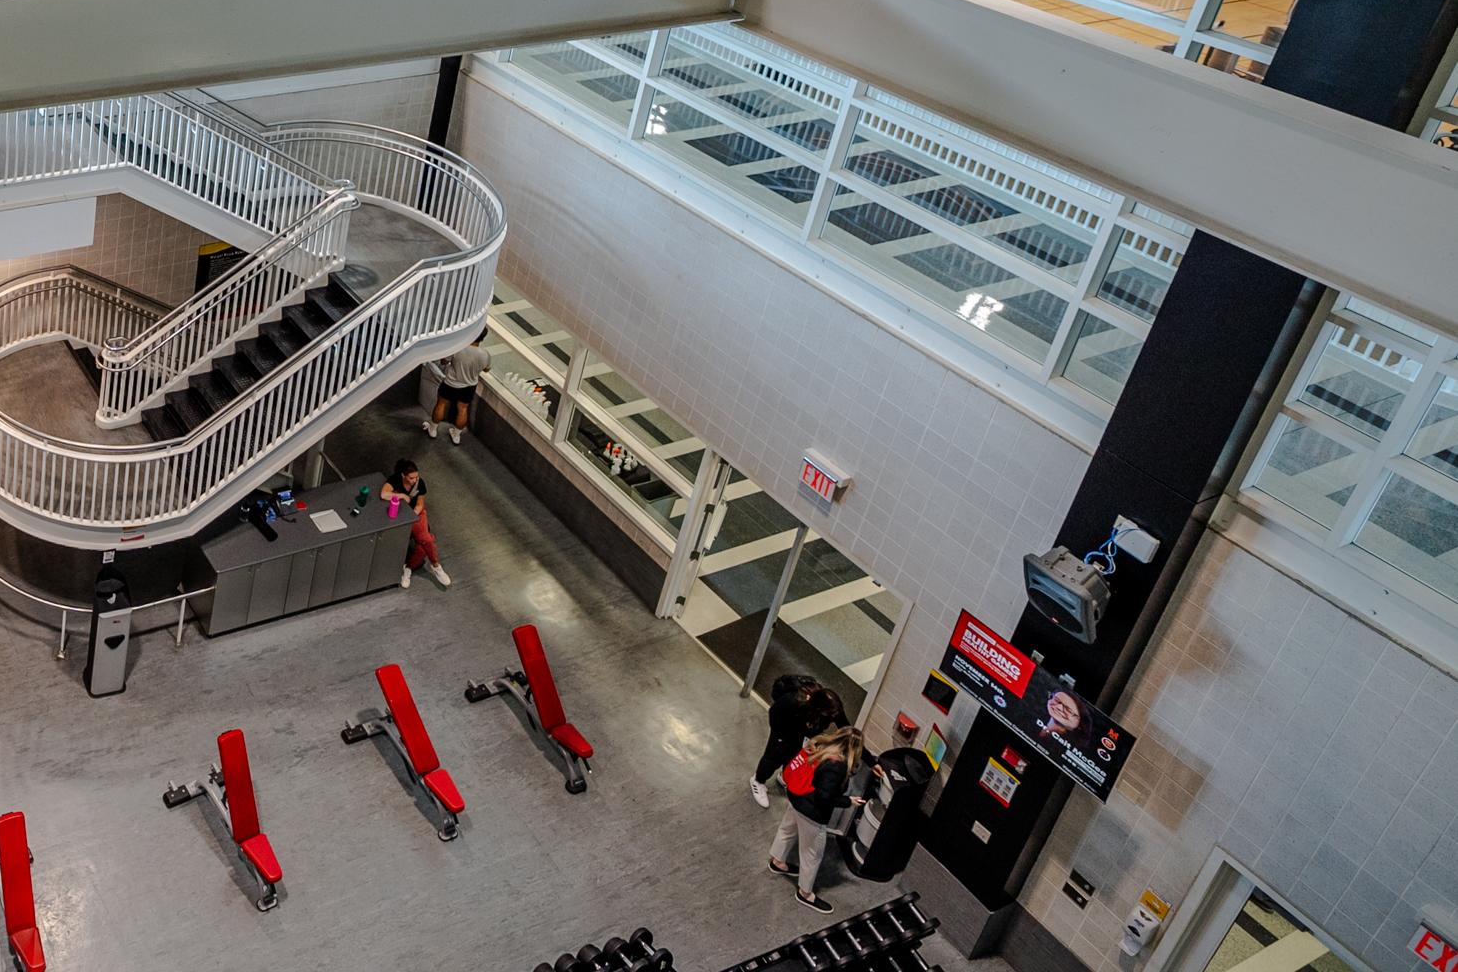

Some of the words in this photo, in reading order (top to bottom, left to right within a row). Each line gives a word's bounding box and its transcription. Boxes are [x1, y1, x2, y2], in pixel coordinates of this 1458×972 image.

[802, 463, 833, 498] EXIT
[954, 654, 990, 684] NOVEMBER
[962, 635, 990, 659] HEALTHY
[989, 657, 1019, 681] GAMERS
[963, 628, 1021, 676] BUILDING
[1036, 718, 1050, 733] Dr.
[1051, 731, 1072, 749] Cait
[1072, 747, 1107, 777] McGee
[1412, 931, 1458, 972] EX
